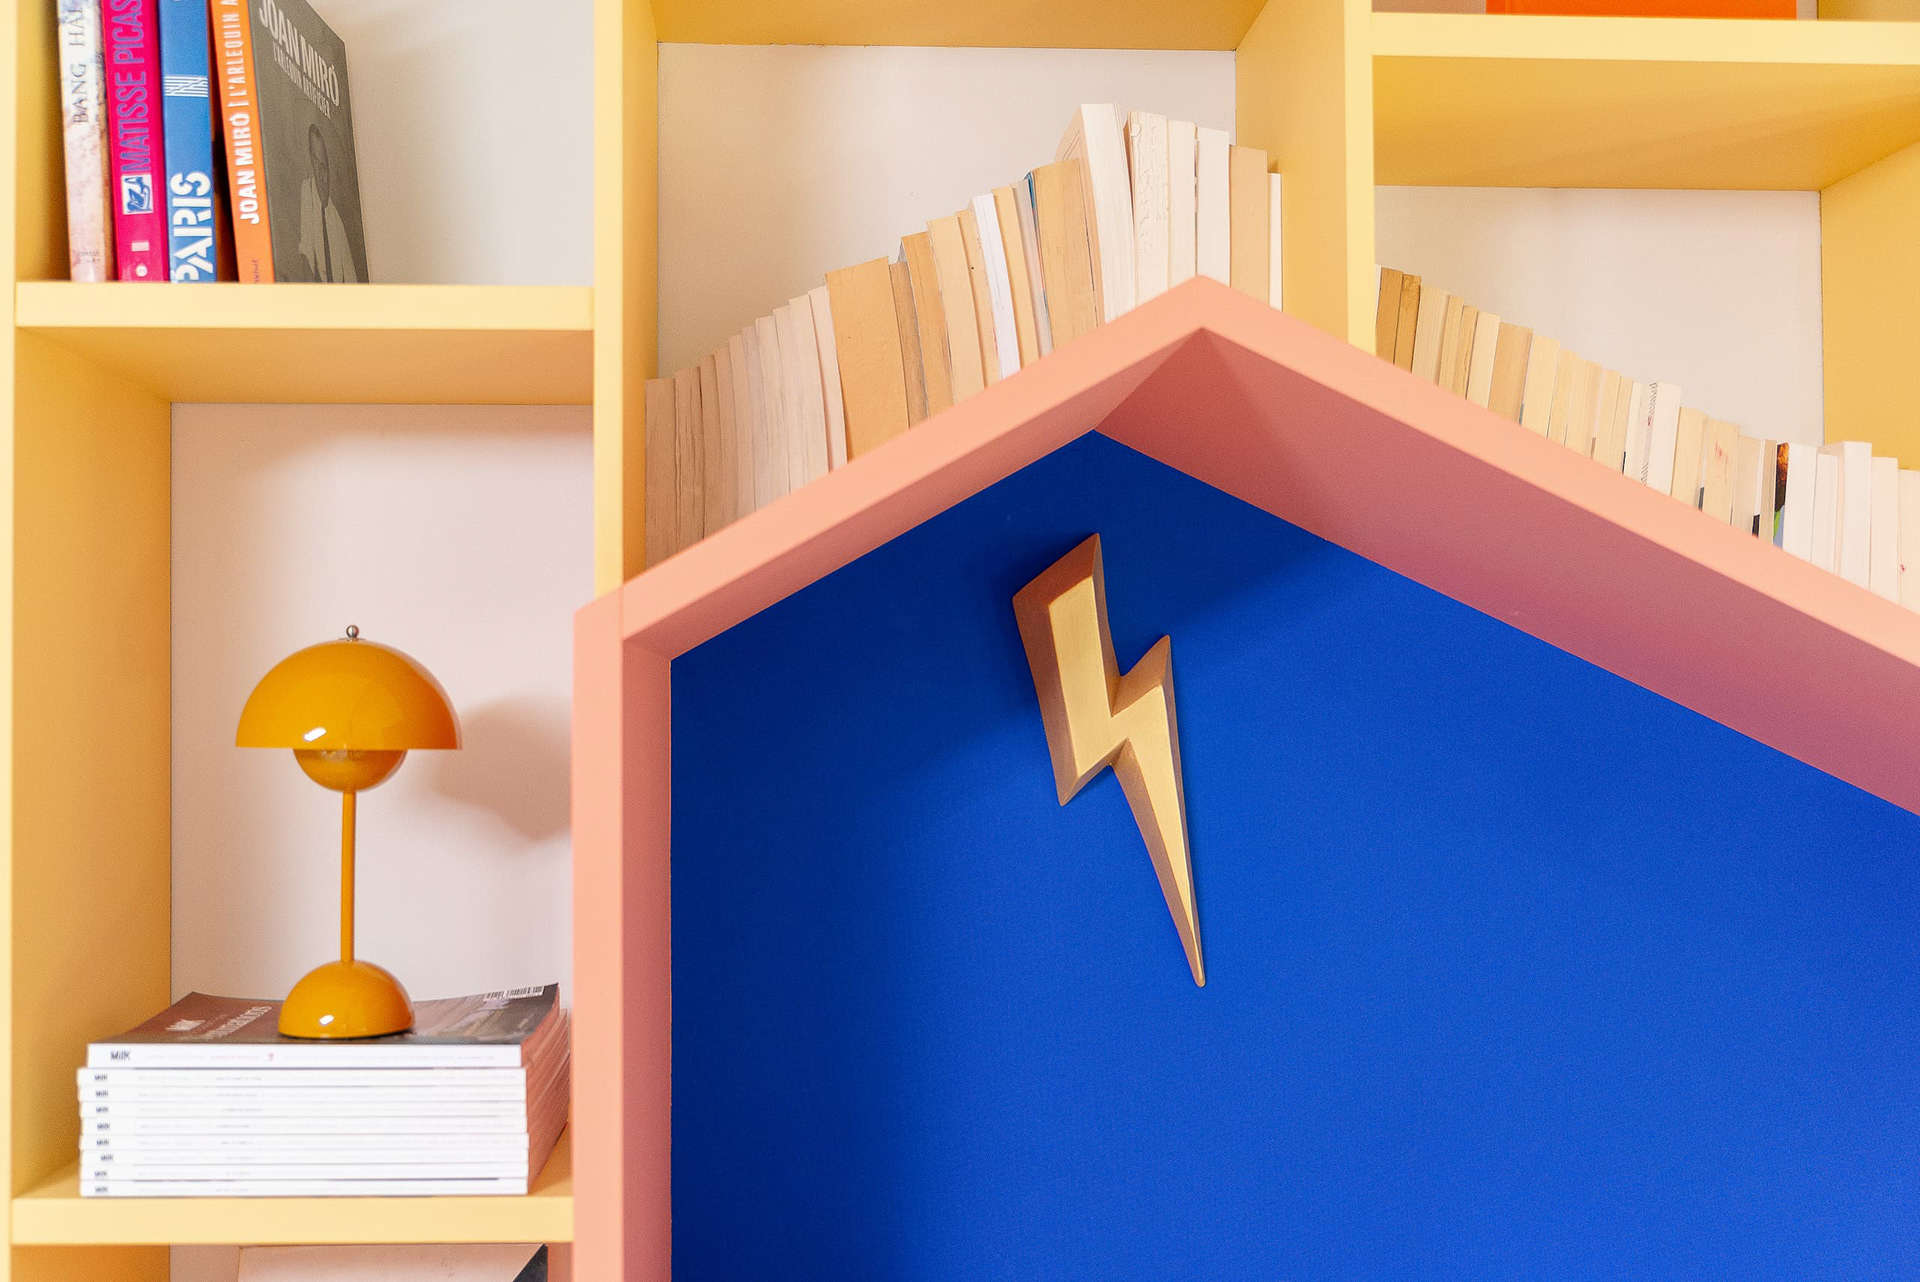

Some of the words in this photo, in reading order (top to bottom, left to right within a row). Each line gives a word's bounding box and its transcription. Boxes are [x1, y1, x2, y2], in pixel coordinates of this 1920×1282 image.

[110, 0, 145, 64] PICAS
[221, 13, 248, 97] L'ARLEQUIN
[258, 0, 301, 67] JOAN
[299, 33, 340, 107] MIRÓ
[70, 63, 89, 123] BANG
[114, 71, 151, 172] MATISSE
[227, 111, 255, 166] MIRÓ
[169, 170, 214, 282] PARIS
[237, 170, 260, 225] JOAN
